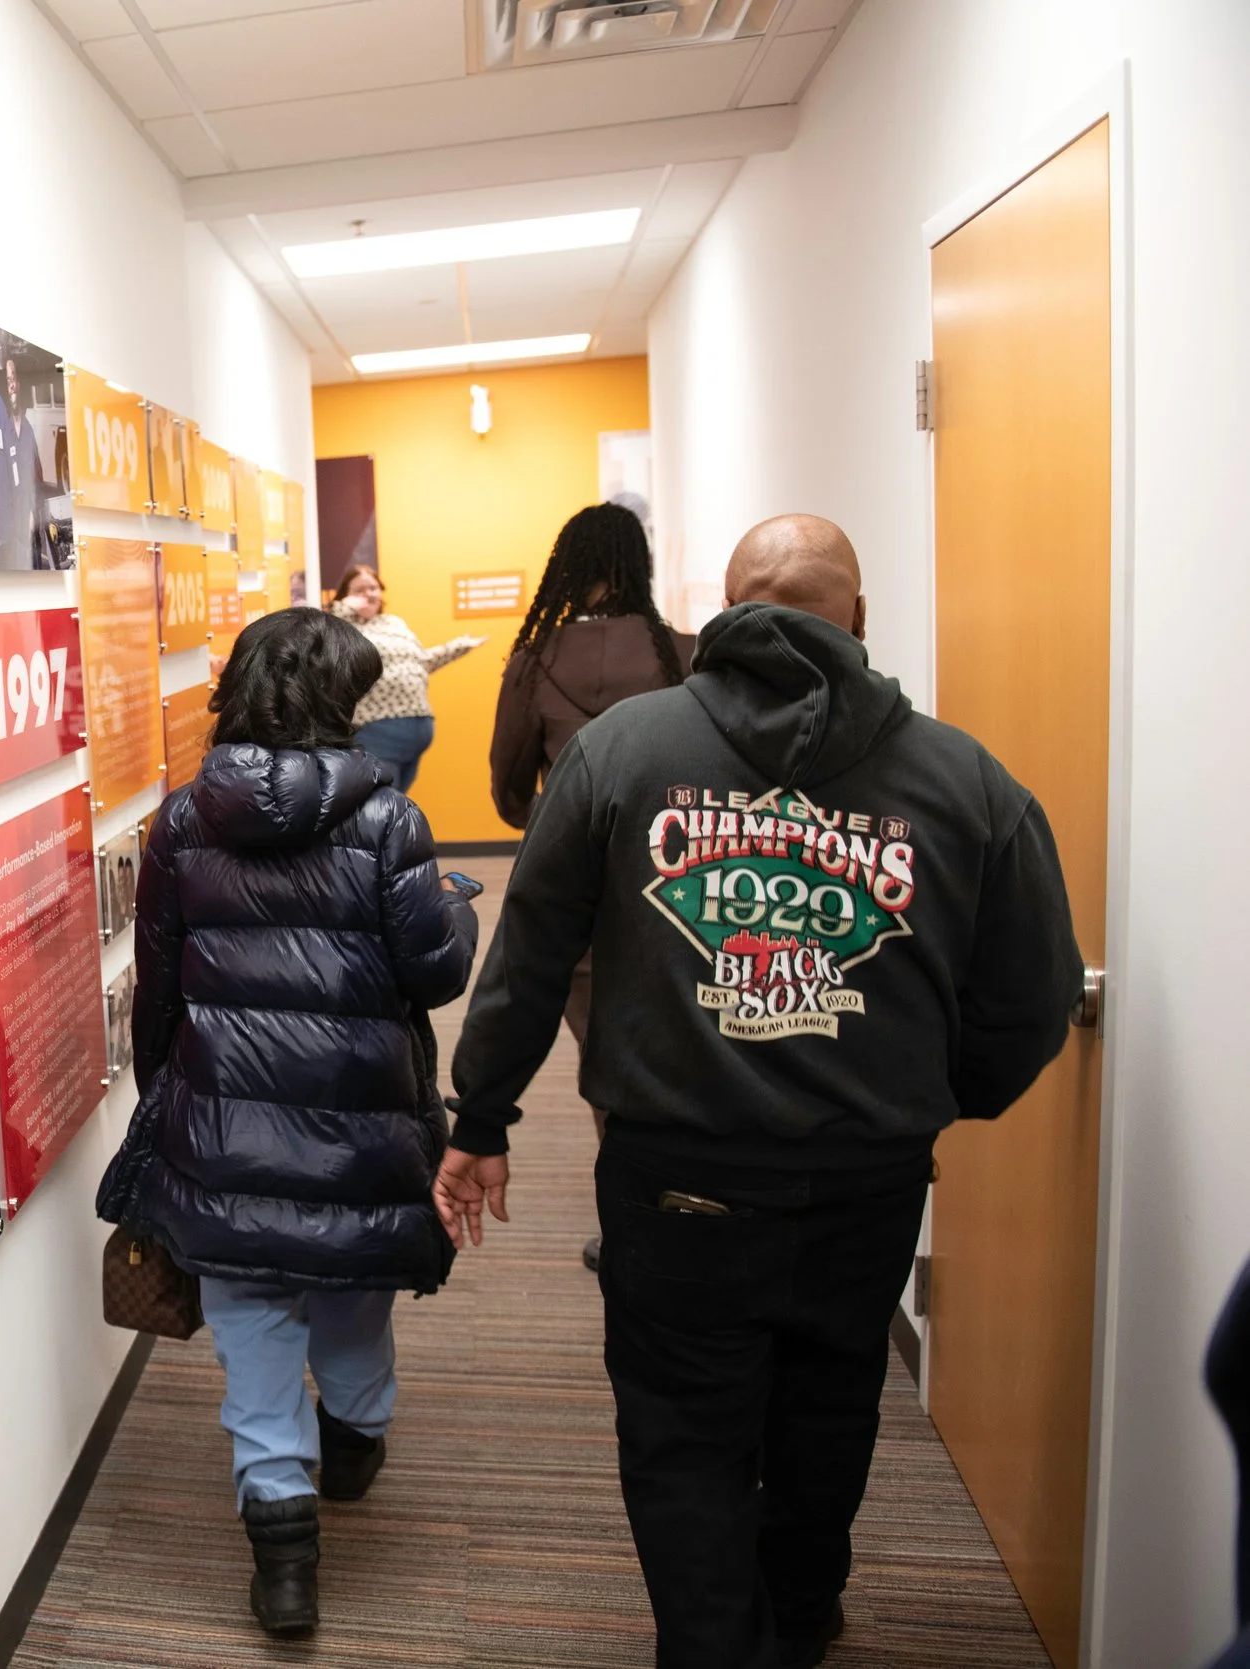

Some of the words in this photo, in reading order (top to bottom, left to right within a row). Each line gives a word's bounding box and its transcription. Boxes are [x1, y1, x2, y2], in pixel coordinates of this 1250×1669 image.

[83, 405, 139, 482] 1999
[165, 571, 206, 627] 2005
[702, 787, 873, 833] LEAGUE
[648, 808, 915, 913] CHAMPIONS
[16, 911, 25, 924] for
[701, 867, 855, 938] 1929
[0, 962, 13, 980] state
[12, 949, 27, 969] based
[7, 937, 17, 952] first
[714, 947, 844, 987] BLACK
[2, 1001, 13, 1018] The
[14, 989, 27, 1008] state
[700, 989, 735, 1005] EST.
[738, 979, 822, 1021] SOX
[825, 993, 859, 1009] 1920
[724, 1020, 785, 1036] AMERICAN
[787, 1016, 833, 1030] LEAGUE
